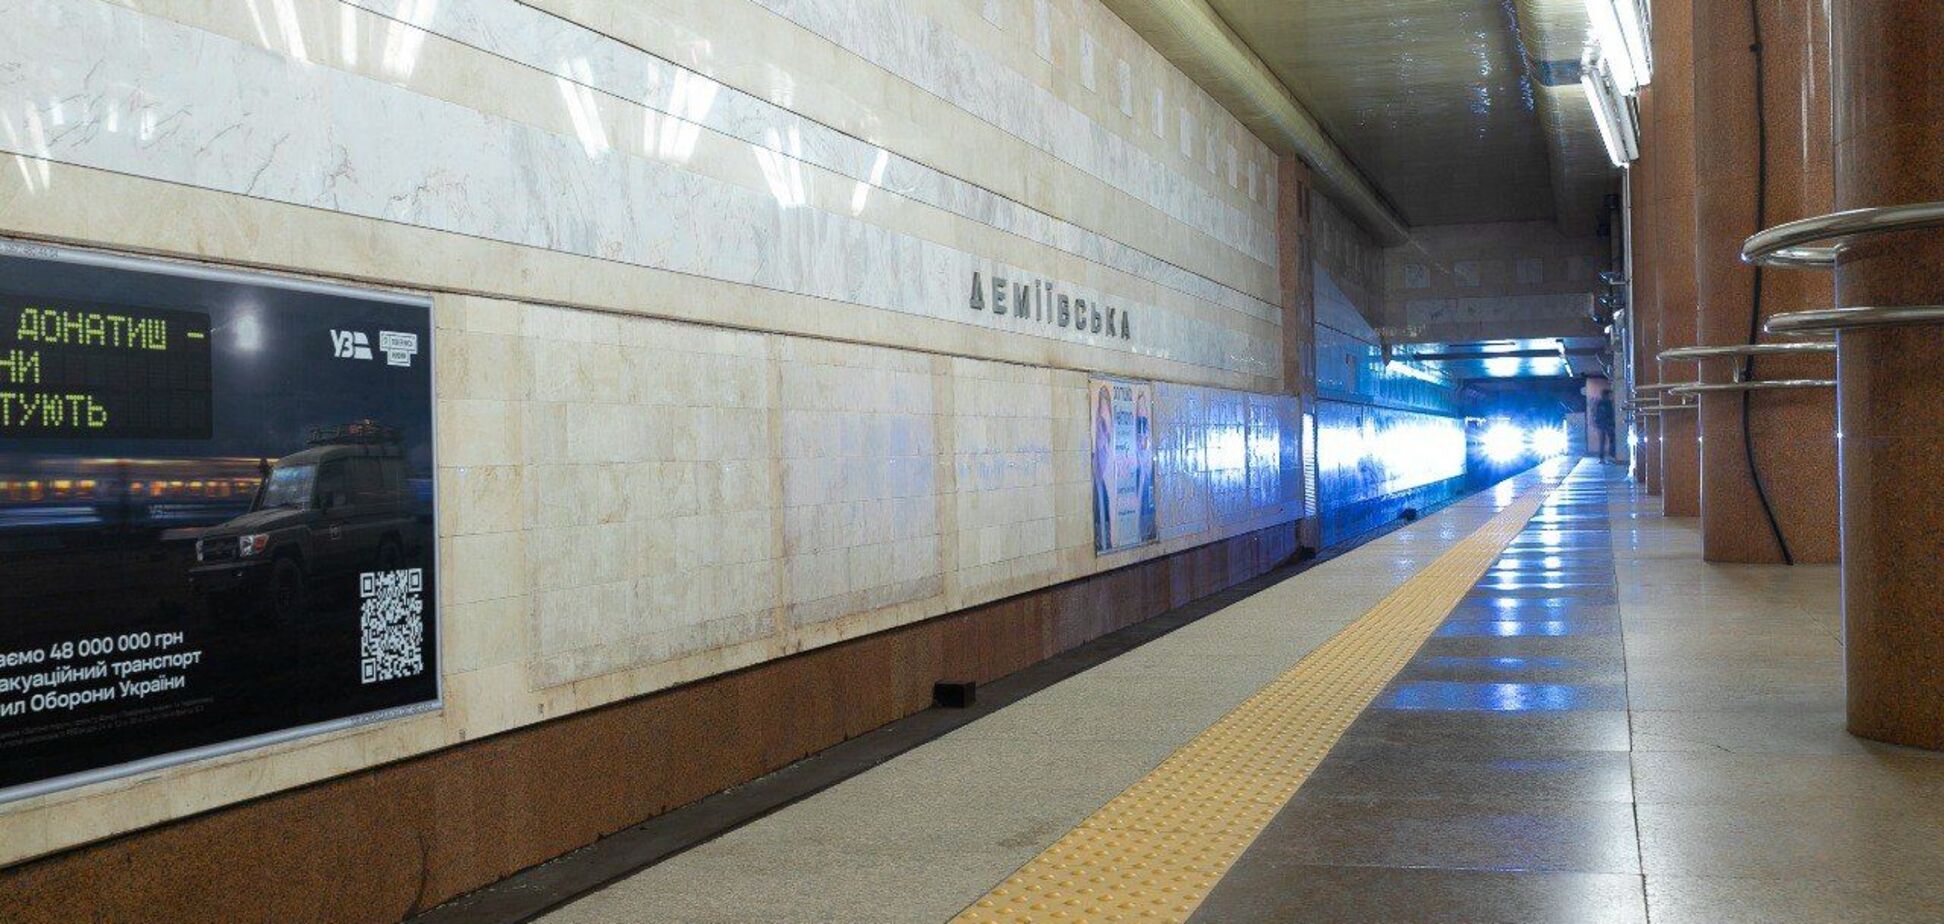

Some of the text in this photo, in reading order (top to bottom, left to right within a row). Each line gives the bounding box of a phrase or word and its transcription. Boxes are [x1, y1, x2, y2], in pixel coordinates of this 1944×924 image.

[969, 271, 1131, 341] ДЕМІЇВСЬКА
[18, 307, 166, 350] ДОНАТИШ
[49, 641, 74, 660] 48
[78, 637, 114, 657] 000
[118, 631, 151, 652] 000
[154, 631, 184, 649] грн
[111, 650, 202, 678] транспорт
[30, 685, 115, 711] Оборони
[119, 675, 185, 699] України
